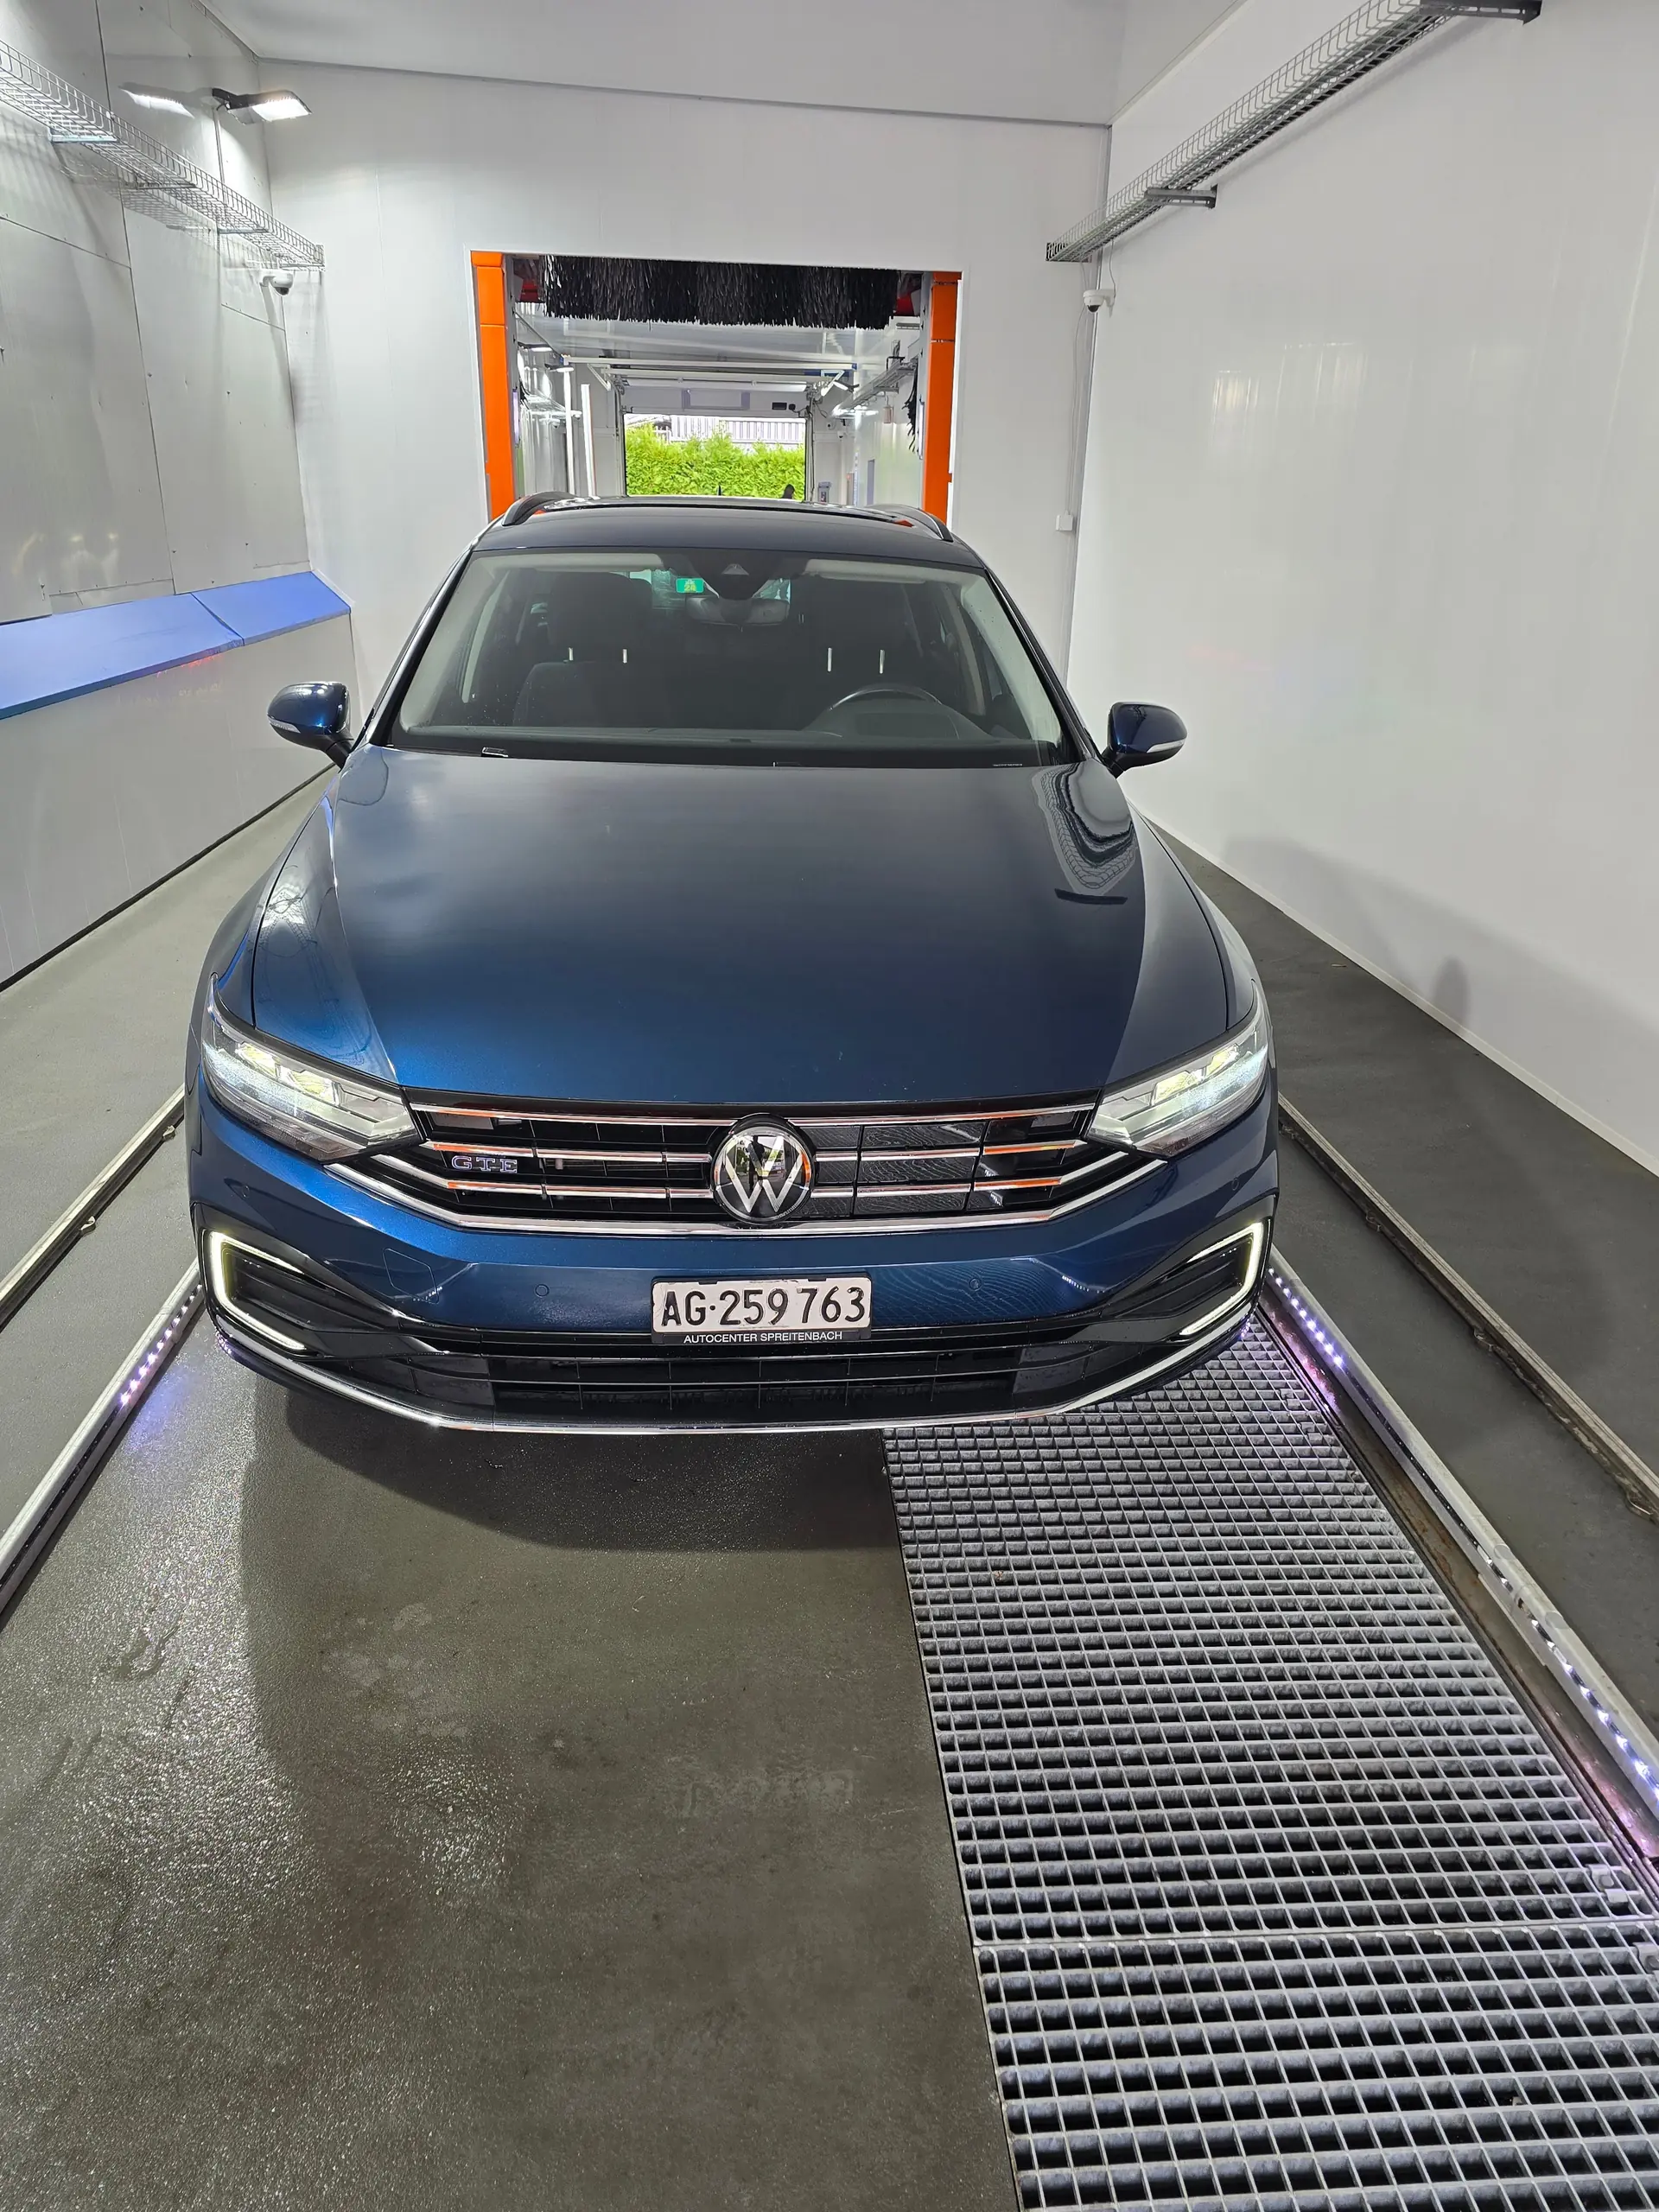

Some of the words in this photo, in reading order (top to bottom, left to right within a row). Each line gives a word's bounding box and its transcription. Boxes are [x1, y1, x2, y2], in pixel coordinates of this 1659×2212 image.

[451, 1154, 518, 1173] GTE
[683, 1333, 758, 1344] AUTOCENTER
[760, 1331, 843, 1342] SPREITENBACH
